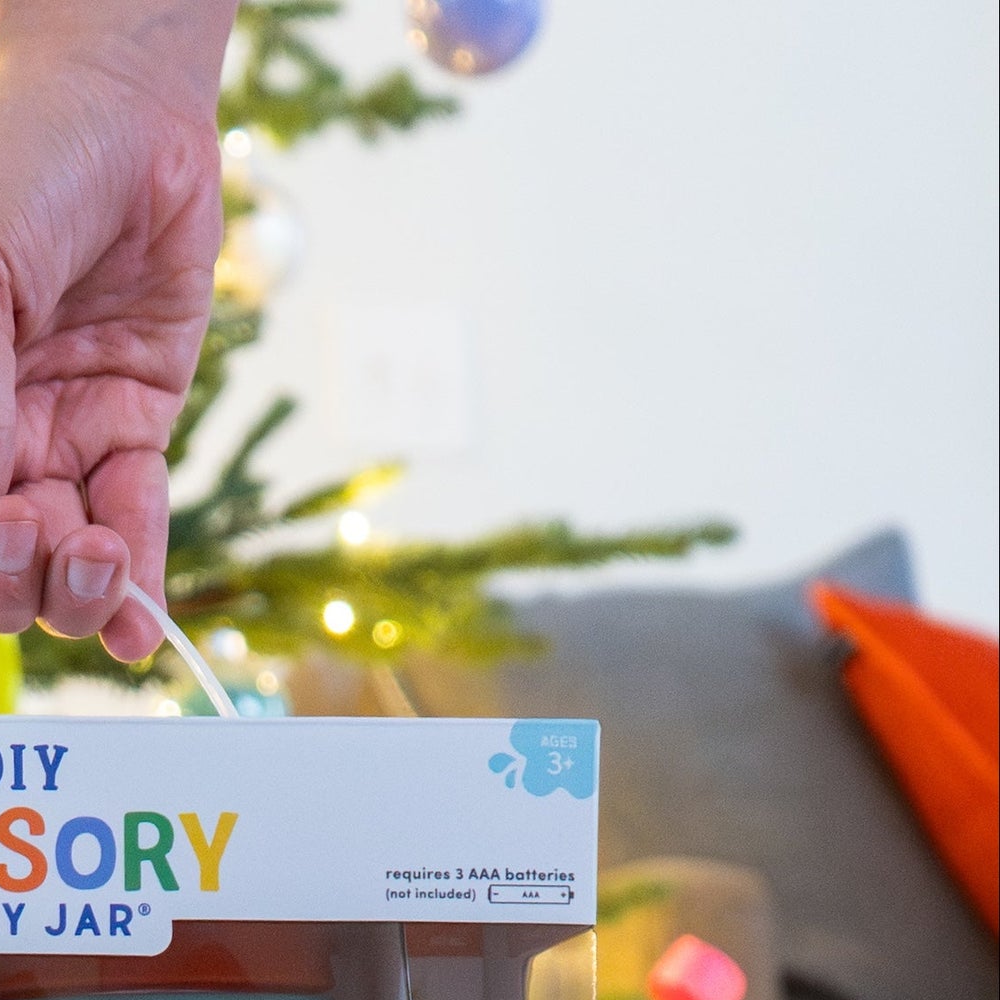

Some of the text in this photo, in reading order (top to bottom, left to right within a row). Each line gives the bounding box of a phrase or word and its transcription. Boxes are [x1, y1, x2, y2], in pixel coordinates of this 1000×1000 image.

[540, 735, 578, 749] AGES
[546, 751, 575, 776] 3+
[386, 867, 576, 883] requires 3 AAA batteries
[385, 888, 477, 902] (not included)
[522, 891, 540, 899] AAA
